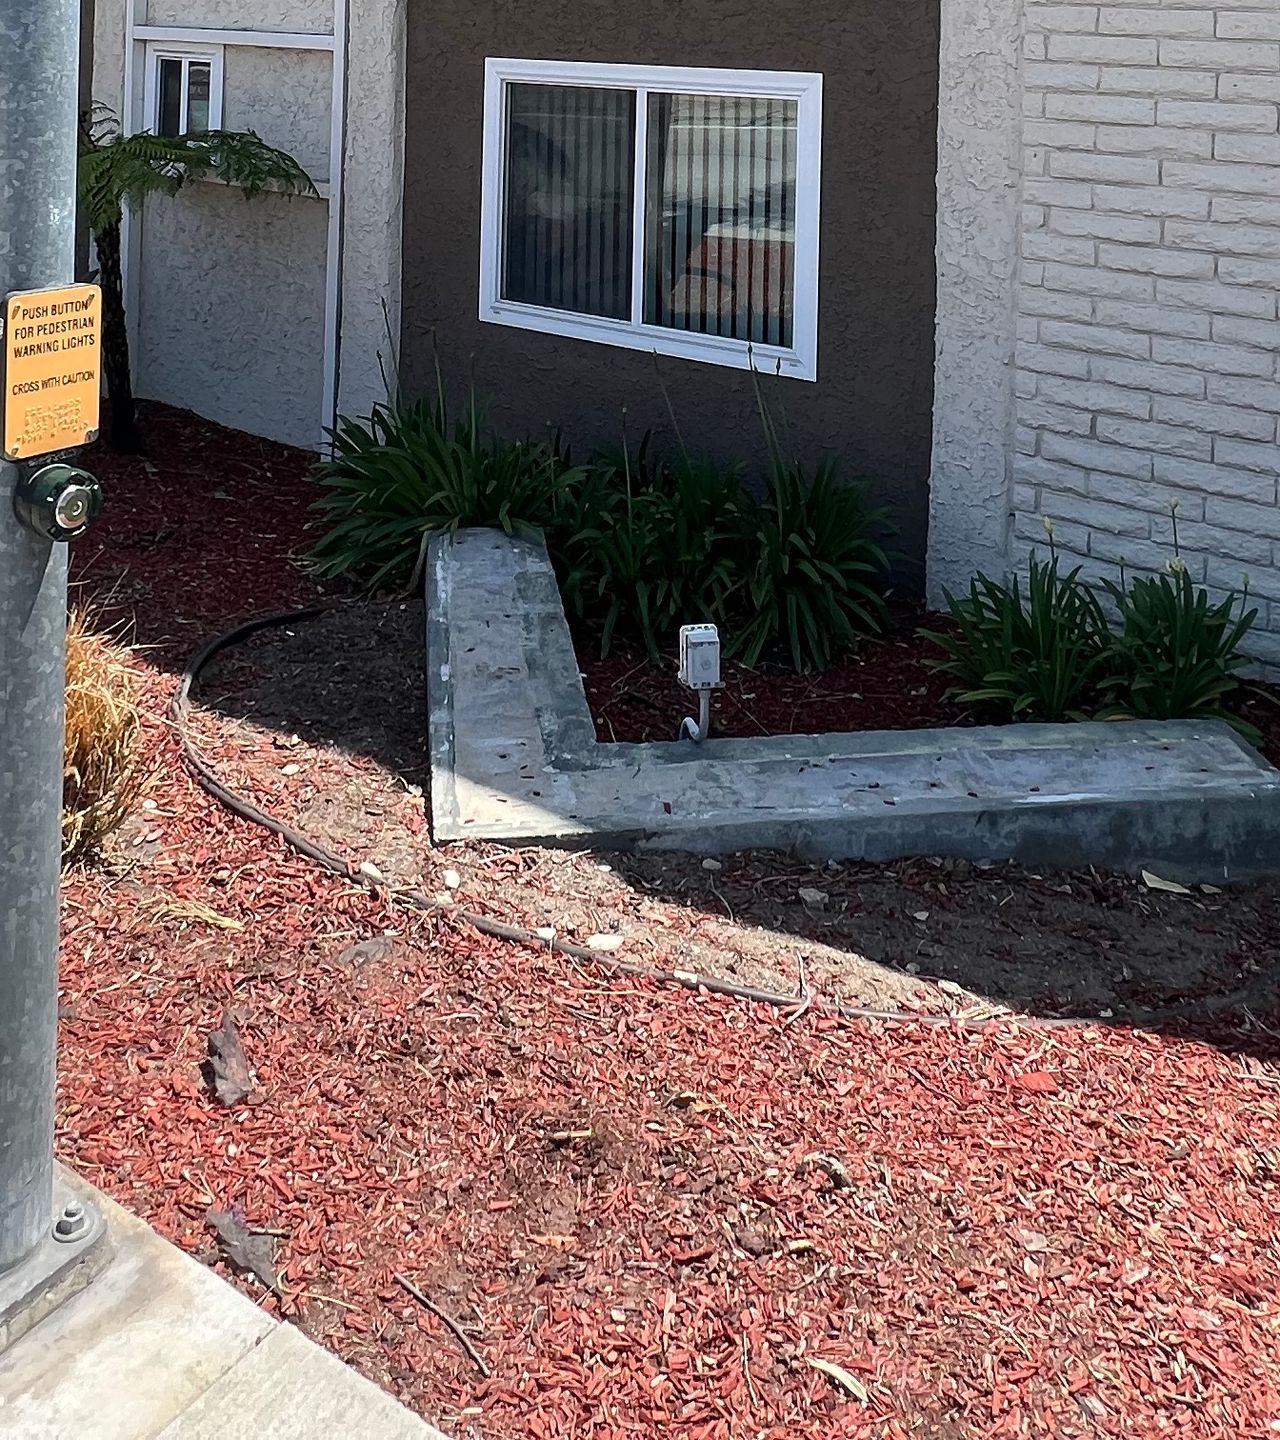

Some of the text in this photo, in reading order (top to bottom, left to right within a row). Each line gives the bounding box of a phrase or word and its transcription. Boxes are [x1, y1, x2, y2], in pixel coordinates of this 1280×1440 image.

[22, 299, 89, 321] PUSH BUTTON
[14, 316, 95, 340] FOR PEDESTRIAN
[13, 333, 95, 359] WARNING LIGHTS
[12, 370, 95, 396] CROSS WITH CAUTION
